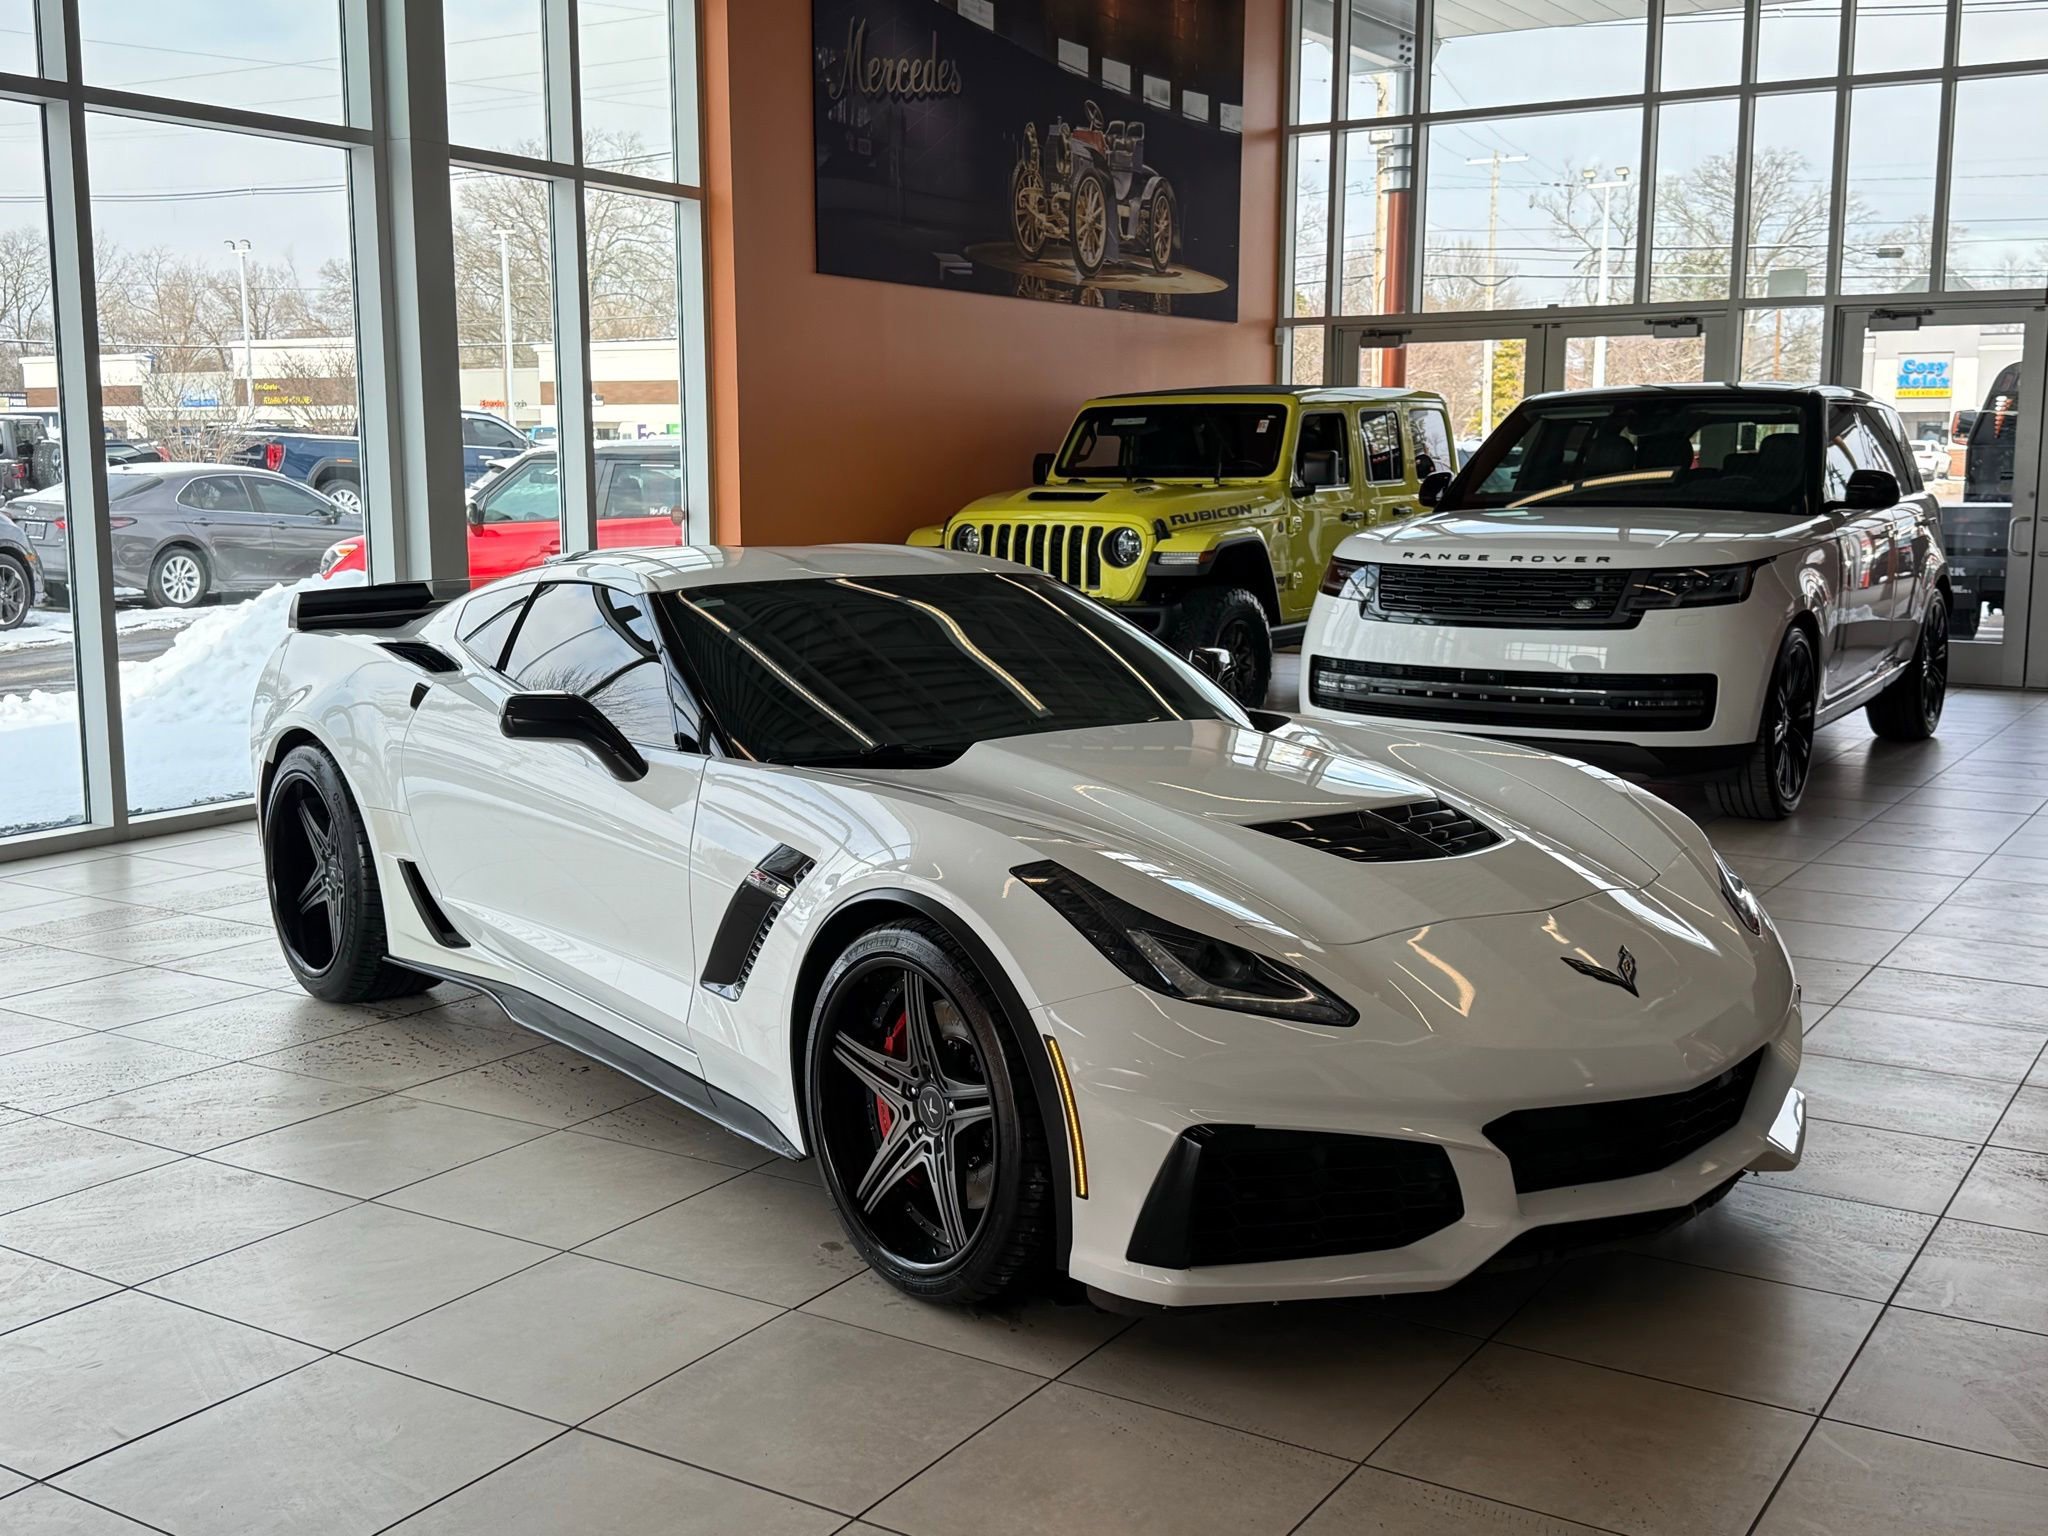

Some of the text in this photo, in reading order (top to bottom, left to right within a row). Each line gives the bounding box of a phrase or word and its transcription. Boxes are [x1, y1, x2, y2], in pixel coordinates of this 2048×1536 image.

[829, 15, 962, 100] Mercedes
[1902, 359, 1948, 377] Cozy
[1897, 374, 1949, 389] Relax
[1169, 504, 1252, 525] RUBICON
[1402, 551, 1611, 563] RANGE ROVER
